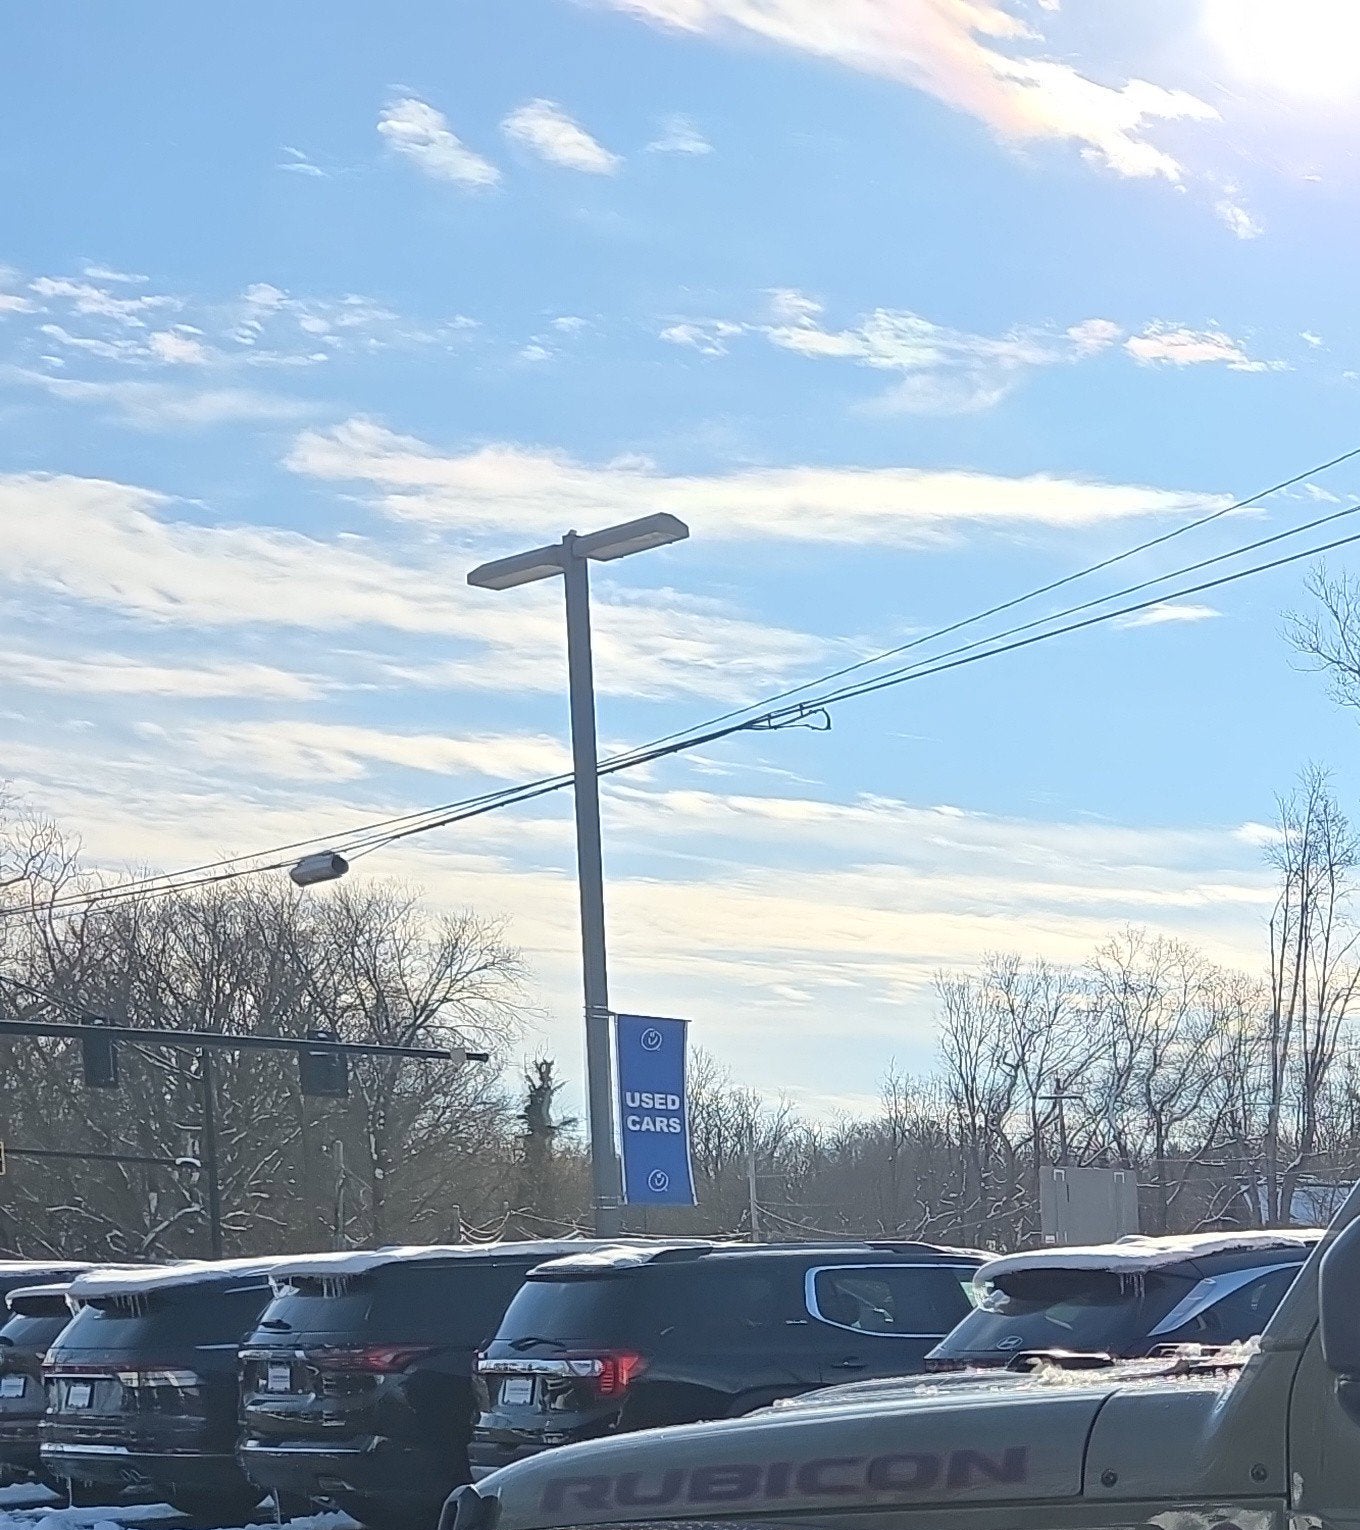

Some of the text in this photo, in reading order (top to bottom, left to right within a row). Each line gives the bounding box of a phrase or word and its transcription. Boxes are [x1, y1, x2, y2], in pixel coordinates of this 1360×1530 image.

[625, 1091, 680, 1111] USED
[626, 1115, 682, 1134] CARS
[540, 1444, 1030, 1515] RUBICON
